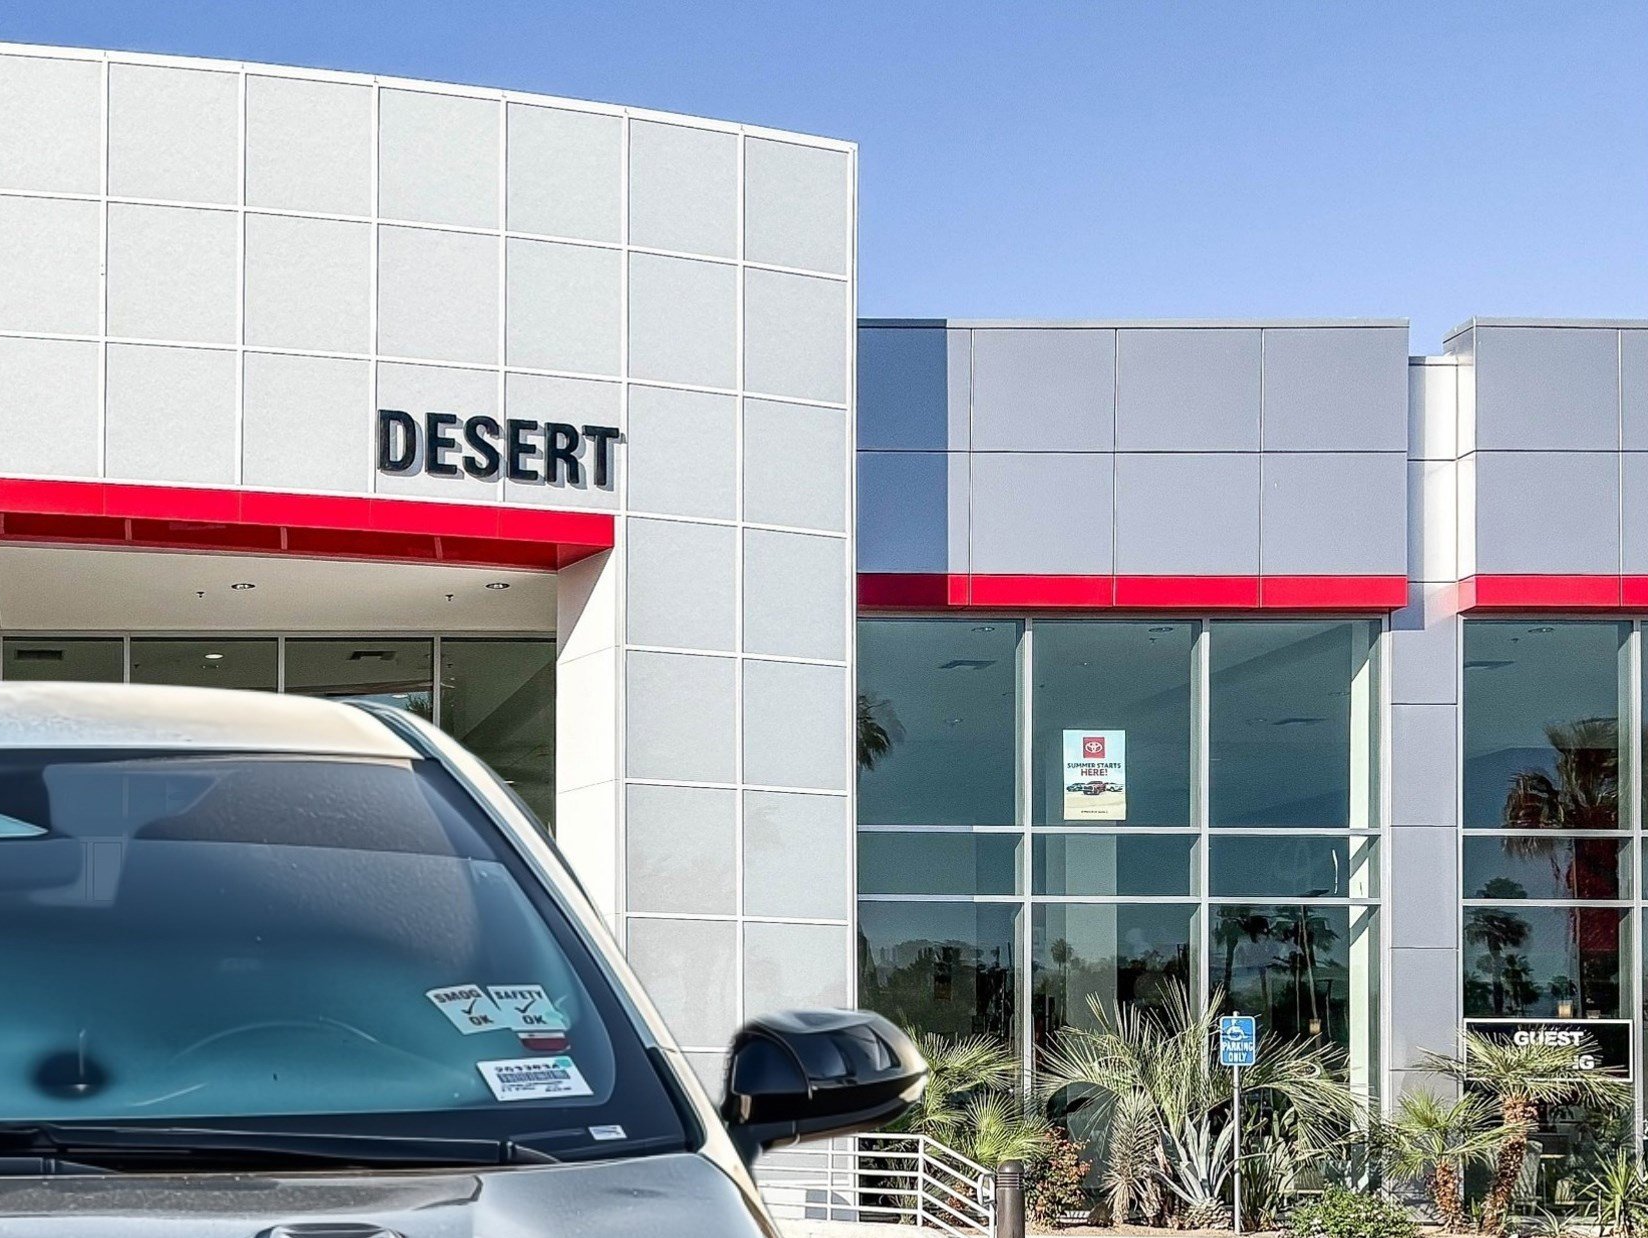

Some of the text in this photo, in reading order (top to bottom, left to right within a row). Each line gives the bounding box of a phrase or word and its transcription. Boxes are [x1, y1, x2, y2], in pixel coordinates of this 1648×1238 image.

[377, 409, 620, 486] DESERT
[433, 989, 483, 1003] SMOG
[493, 990, 544, 1000] SAFETY
[469, 1014, 494, 1026] OK
[522, 1014, 548, 1025] OK
[1513, 1030, 1584, 1046] GUEST
[1222, 1041, 1253, 1052] PARKING
[1228, 1051, 1248, 1063] ONLY
